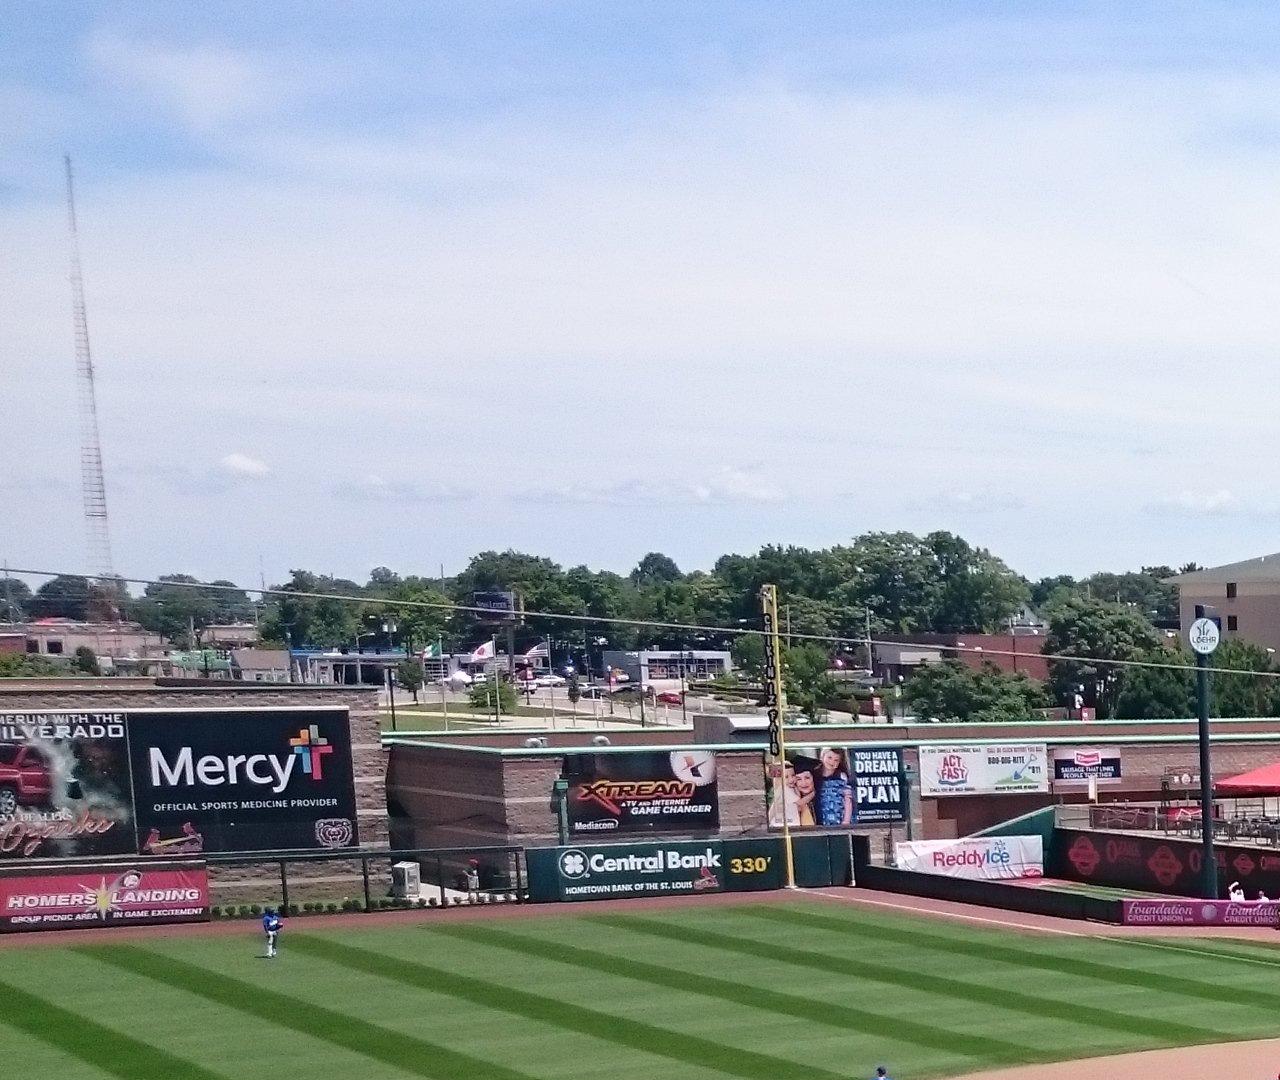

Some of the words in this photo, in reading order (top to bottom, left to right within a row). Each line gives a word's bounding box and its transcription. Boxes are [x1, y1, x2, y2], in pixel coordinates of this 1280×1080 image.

[52, 714, 89, 724] WITH
[95, 713, 123, 723] THE
[0, 724, 124, 739] ILVERADO
[855, 752, 871, 760] YOU
[892, 751, 897, 759] A
[943, 755, 962, 768] ACT
[149, 746, 297, 793] Mercy
[855, 760, 899, 773] DREAM
[941, 768, 965, 780] FAST
[856, 777, 869, 786] WE
[871, 777, 892, 785] HAVE
[893, 776, 899, 785] A
[578, 780, 696, 810] XTREAM
[857, 786, 900, 803] PLAN
[153, 803, 198, 812] OFFICIAL
[201, 801, 239, 810] SPORTS
[241, 799, 288, 809] MEDICINE
[291, 798, 338, 807] PROVIDER
[631, 806, 661, 815] GAME
[662, 804, 712, 814] CHANGER
[575, 821, 616, 830] Mediacom
[590, 850, 664, 872] Central
[667, 848, 722, 869] Bank
[565, 884, 610, 895] HOMETOWN
[612, 882, 633, 892] BANK
[634, 882, 645, 891] OF
[646, 882, 658, 890] THE
[660, 881, 670, 890] ST.
[672, 881, 692, 889] LOUIS
[8, 893, 98, 908] HOMERS
[111, 888, 200, 904] LANDING
[11, 916, 41, 924] GROUP
[75, 913, 98, 921] AREA
[125, 910, 149, 918] GAME
[151, 908, 203, 917] EXCITEMENT
[1127, 914, 1156, 922] CREDIT
[1157, 914, 1184, 922] UNION
[1224, 915, 1252, 923] CREDIT
